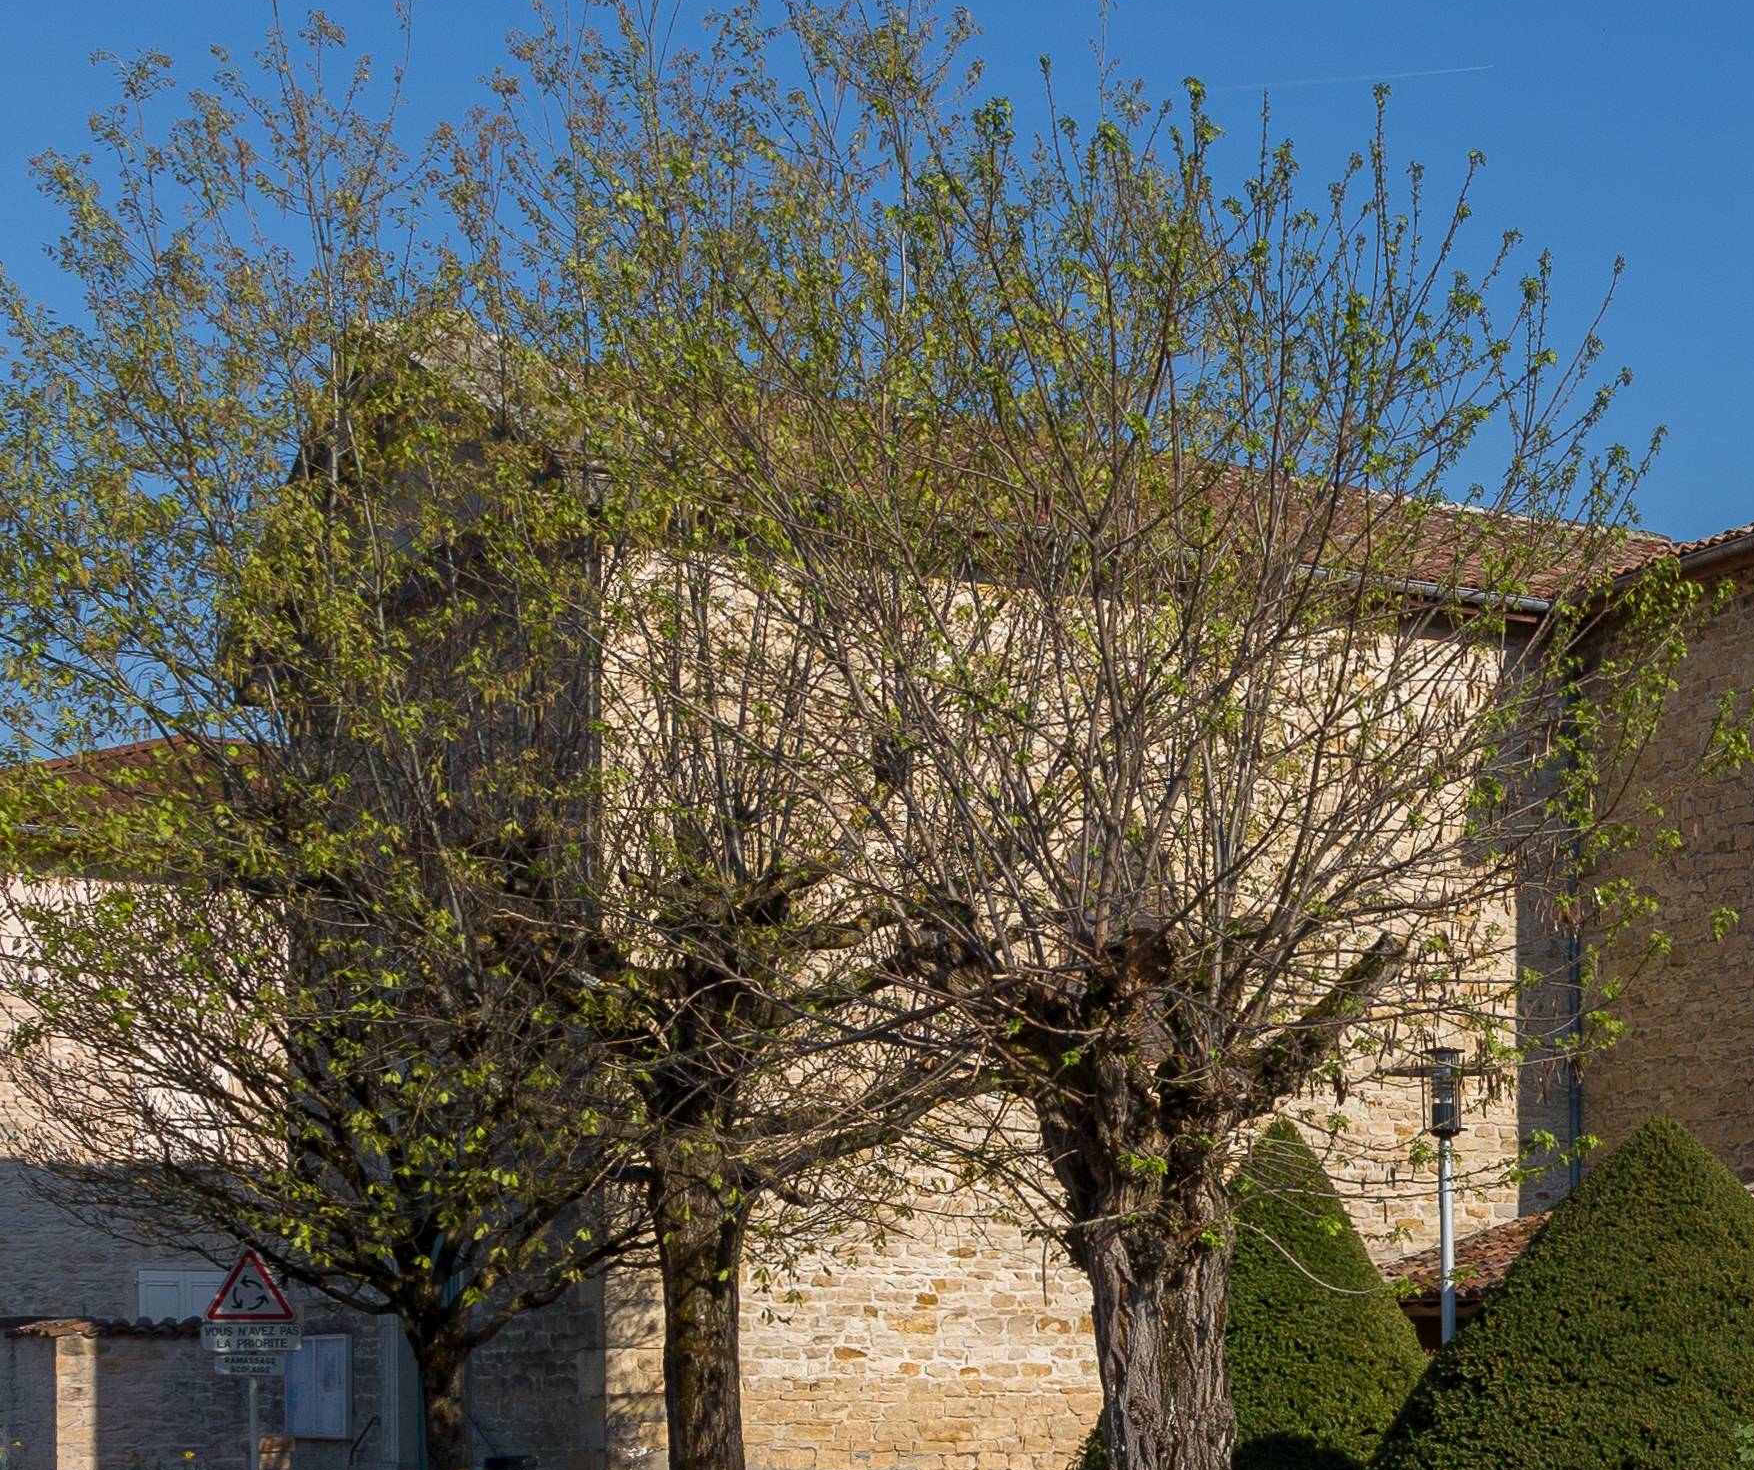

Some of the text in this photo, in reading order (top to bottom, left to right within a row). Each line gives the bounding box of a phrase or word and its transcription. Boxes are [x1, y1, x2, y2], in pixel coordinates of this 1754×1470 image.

[204, 1325, 300, 1337] VOUS N'AVEZ PAS
[216, 1337, 287, 1349] LA PRIORITE
[224, 1356, 276, 1365] RAMASSAGE
